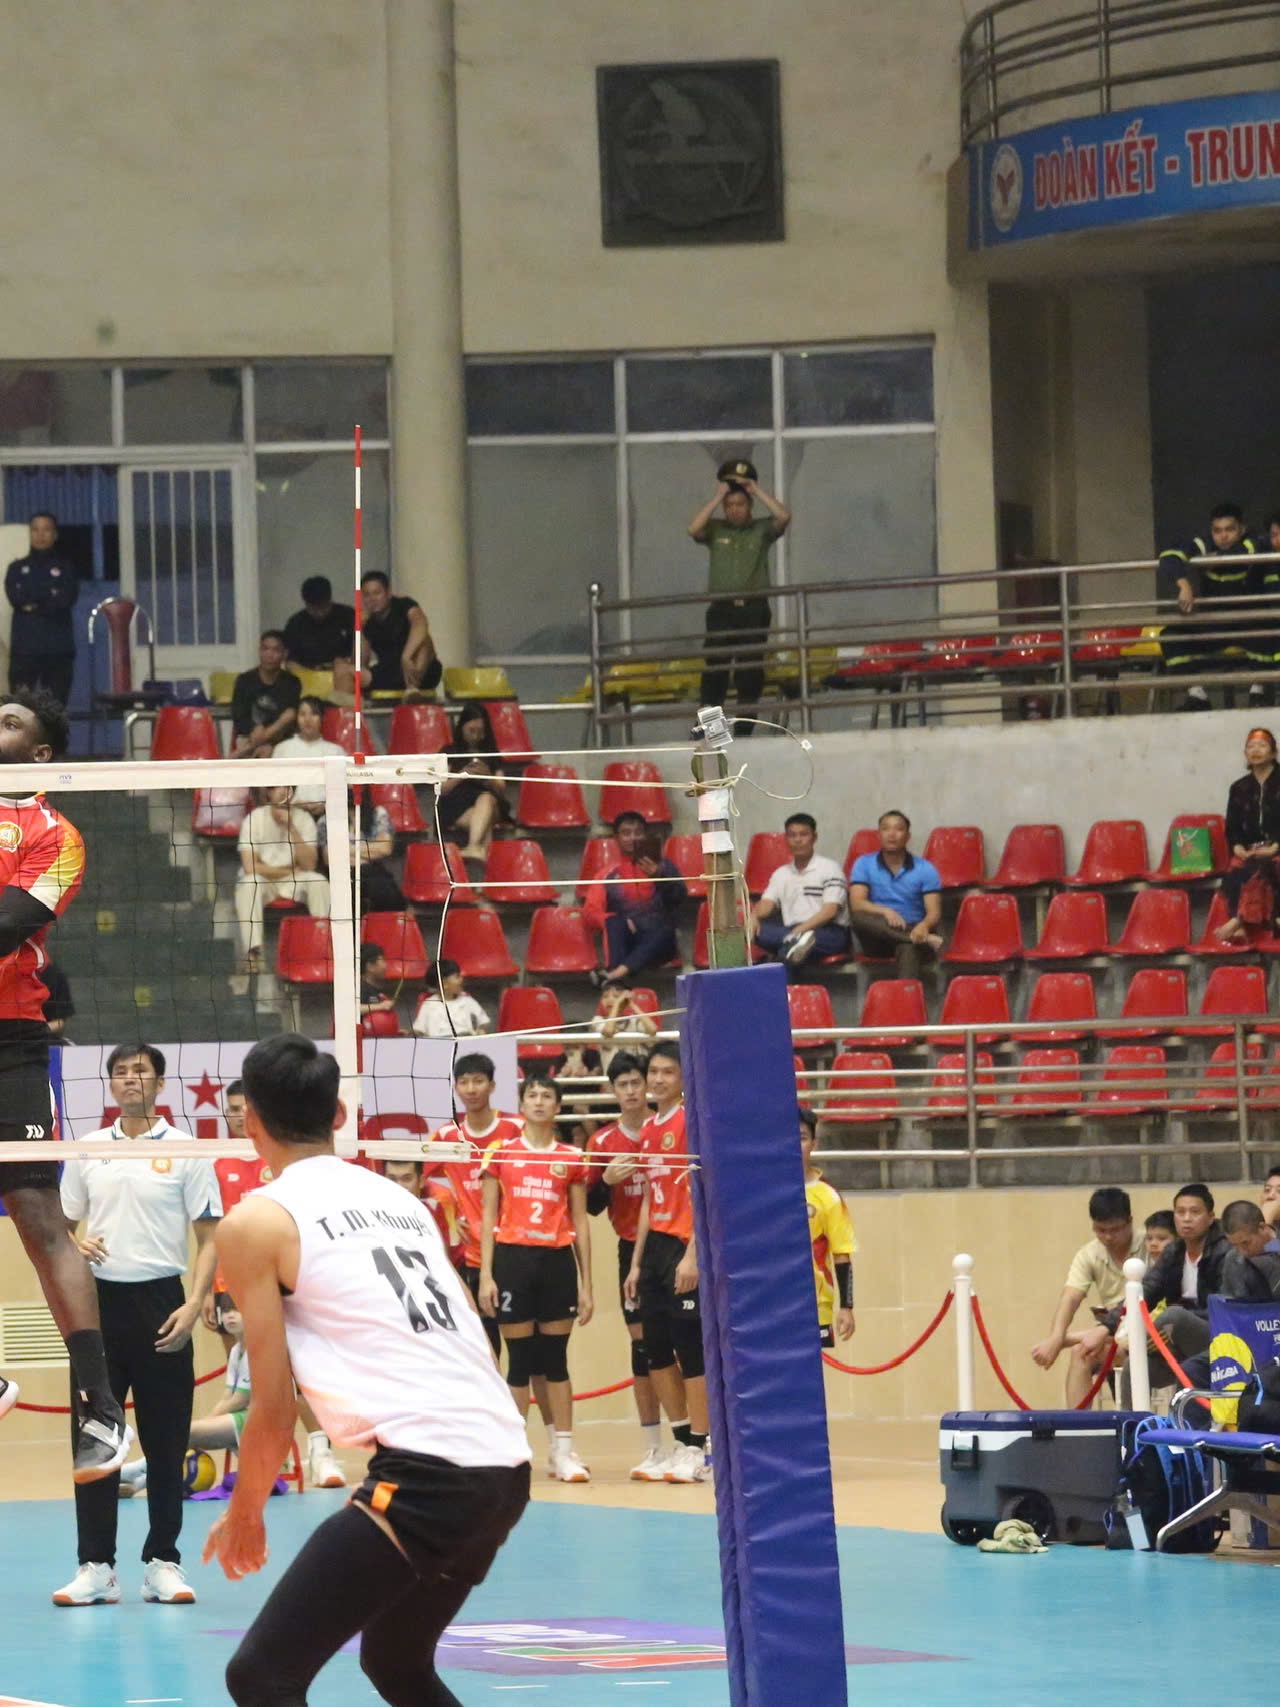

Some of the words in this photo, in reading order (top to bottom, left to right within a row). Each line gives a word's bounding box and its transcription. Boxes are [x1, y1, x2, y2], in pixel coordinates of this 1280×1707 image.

[1034, 137, 1097, 209] ĐOÀN
[1104, 119, 1157, 197] KẾT
[529, 1201, 544, 1224] 2
[316, 1217, 345, 1240] T.
[371, 1245, 458, 1333] 13
[501, 1291, 512, 1312] 2
